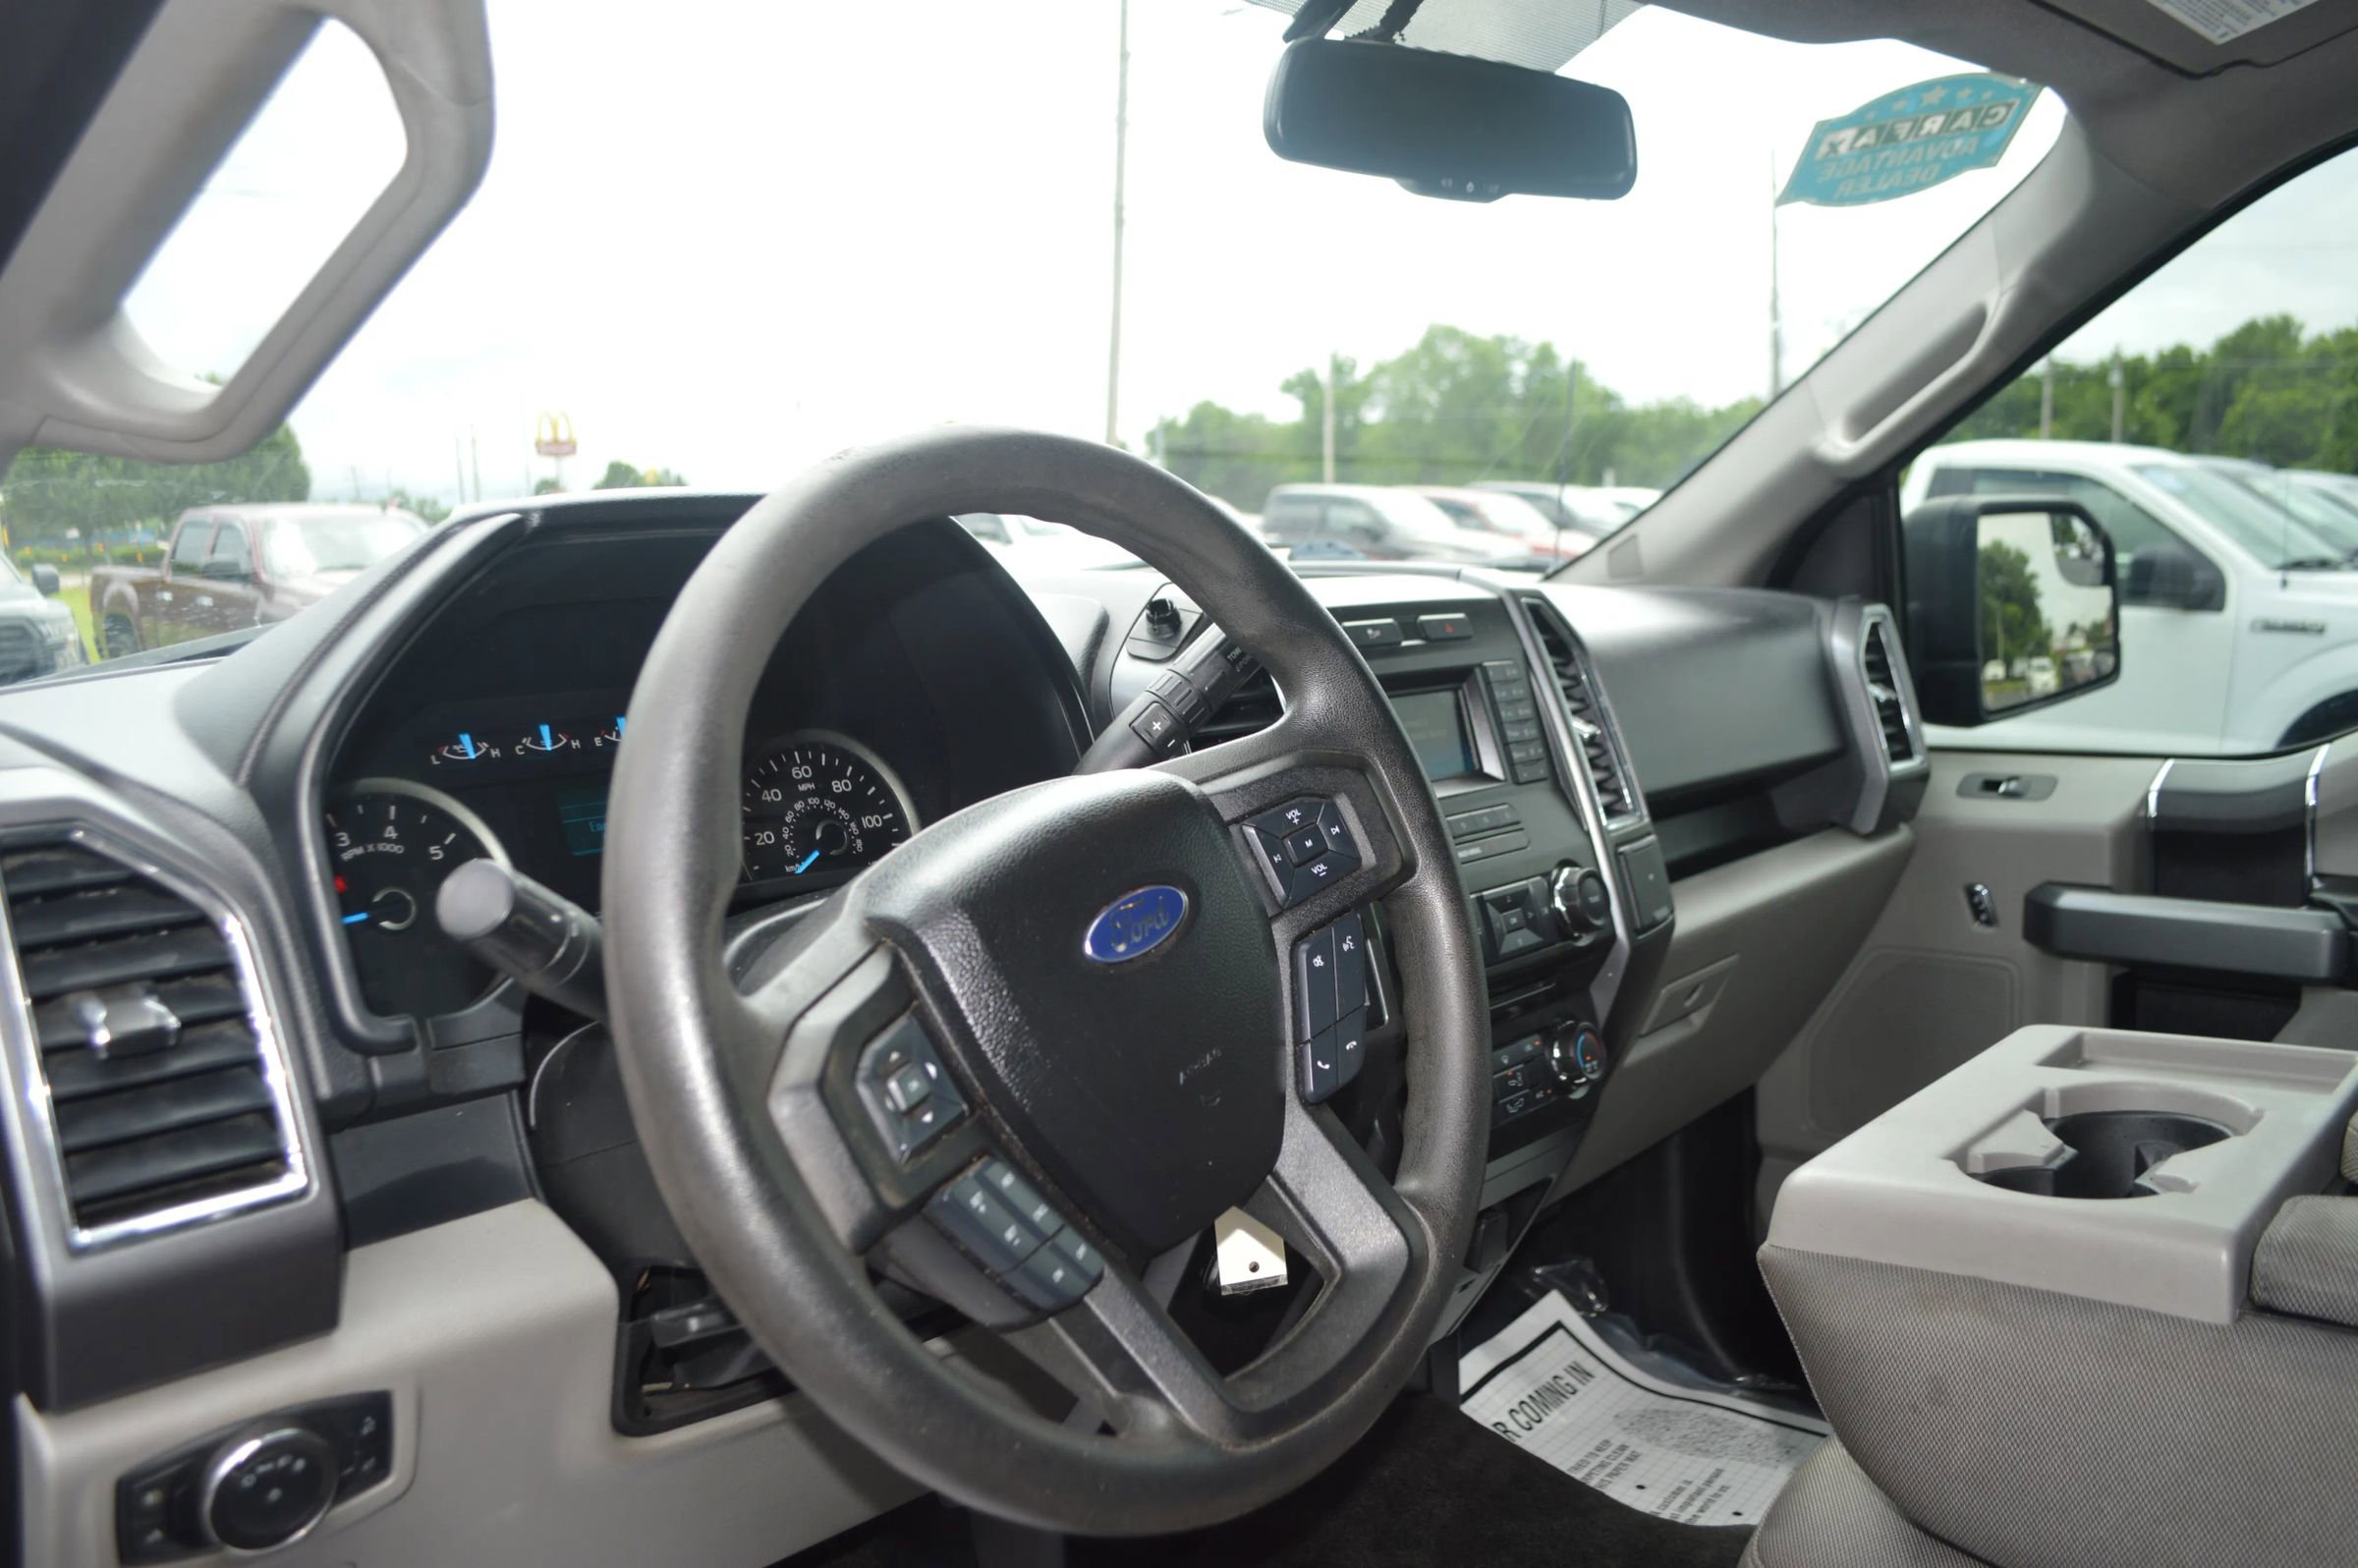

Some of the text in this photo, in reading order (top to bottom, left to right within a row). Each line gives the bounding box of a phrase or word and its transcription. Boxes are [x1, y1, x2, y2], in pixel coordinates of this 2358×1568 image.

[571, 739, 582, 750] H
[593, 737, 603, 747] E
[490, 749, 501, 758] H
[515, 745, 526, 755] C
[430, 755, 440, 764] L
[792, 765, 812, 779] 60
[798, 782, 815, 792] MPH
[832, 779, 852, 793] 80
[761, 789, 782, 802] 40
[794, 801, 805, 812] 80
[808, 797, 819, 806] 100
[823, 799, 835, 809] 120
[785, 811, 794, 822] 60
[838, 808, 849, 819] 140
[1285, 809, 1302, 820] VOL
[862, 814, 882, 828] 100
[383, 825, 398, 839] 4
[336, 831, 351, 847] 3
[755, 831, 774, 845] 20
[1305, 839, 1314, 848] M
[341, 844, 365, 862] RPM
[376, 842, 404, 854] 1000
[428, 845, 444, 860] 5
[1311, 864, 1327, 874] VOL
[1108, 894, 1171, 953] Ford
[1492, 1361, 1596, 1442] R COMING IN
